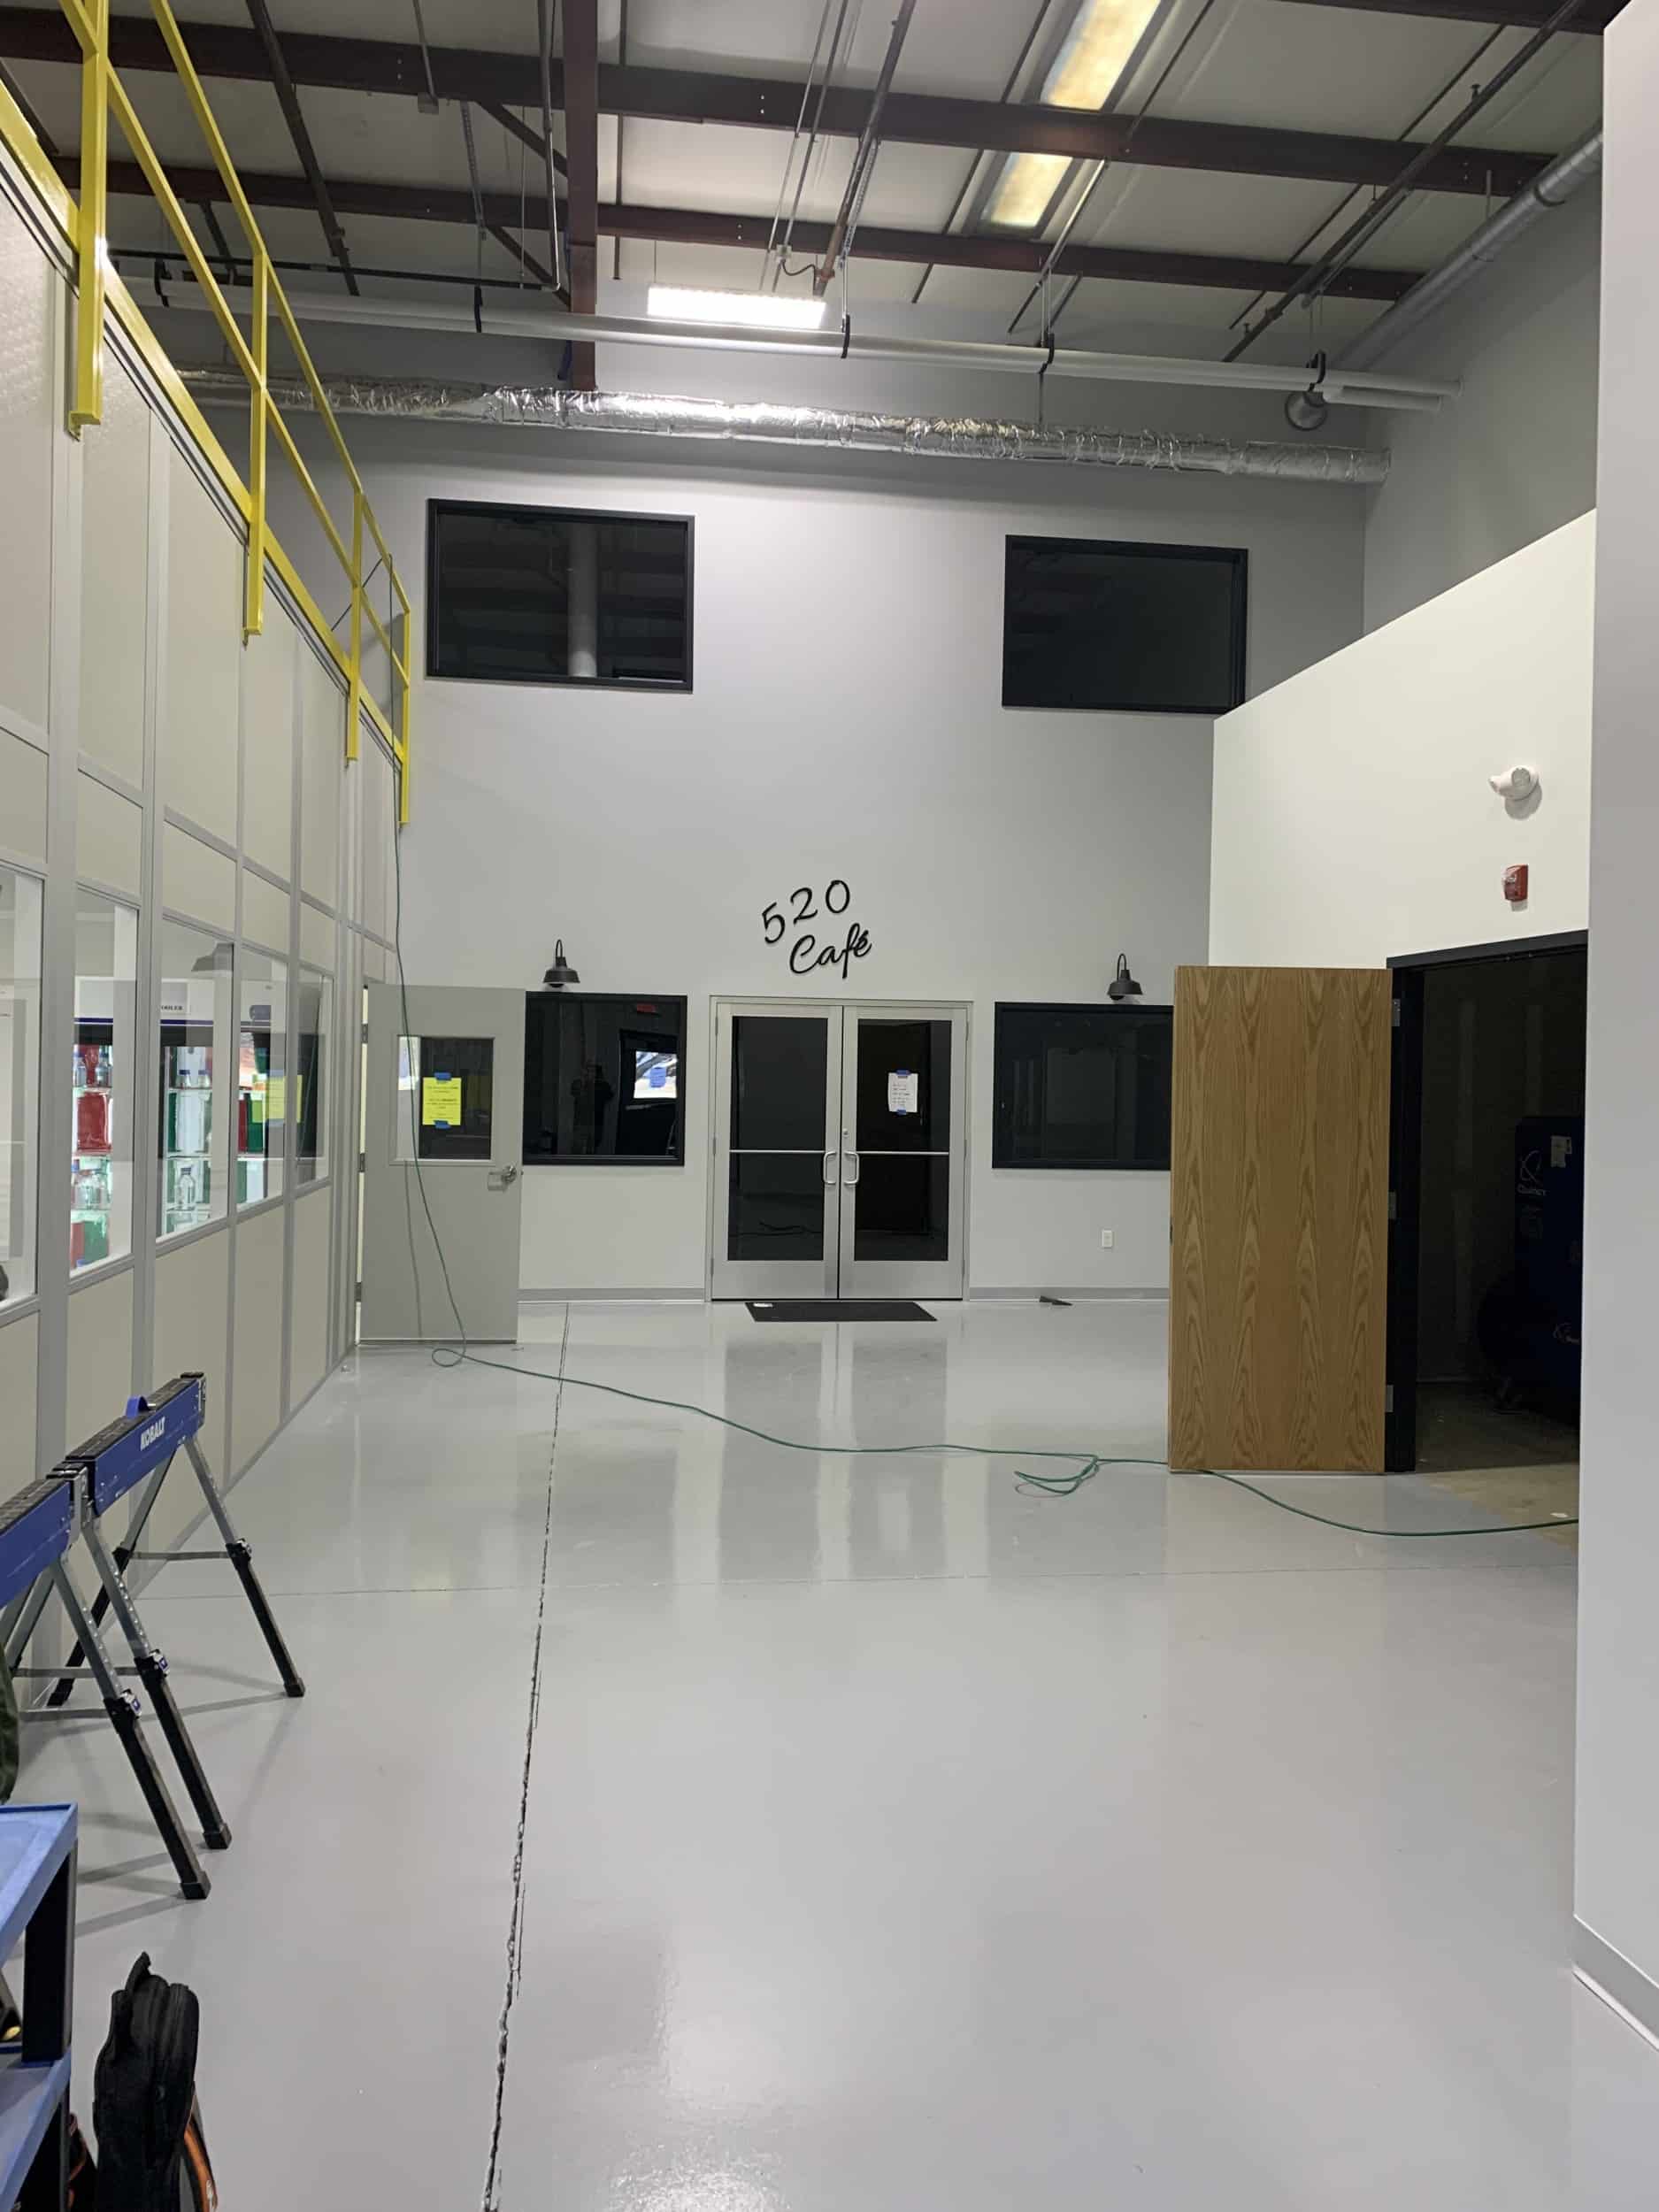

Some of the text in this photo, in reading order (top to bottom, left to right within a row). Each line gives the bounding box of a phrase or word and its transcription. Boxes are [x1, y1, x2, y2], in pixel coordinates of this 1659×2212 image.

[762, 879, 850, 944] 520
[789, 922, 872, 979] Café
[140, 1416, 166, 1452] KOBALT
